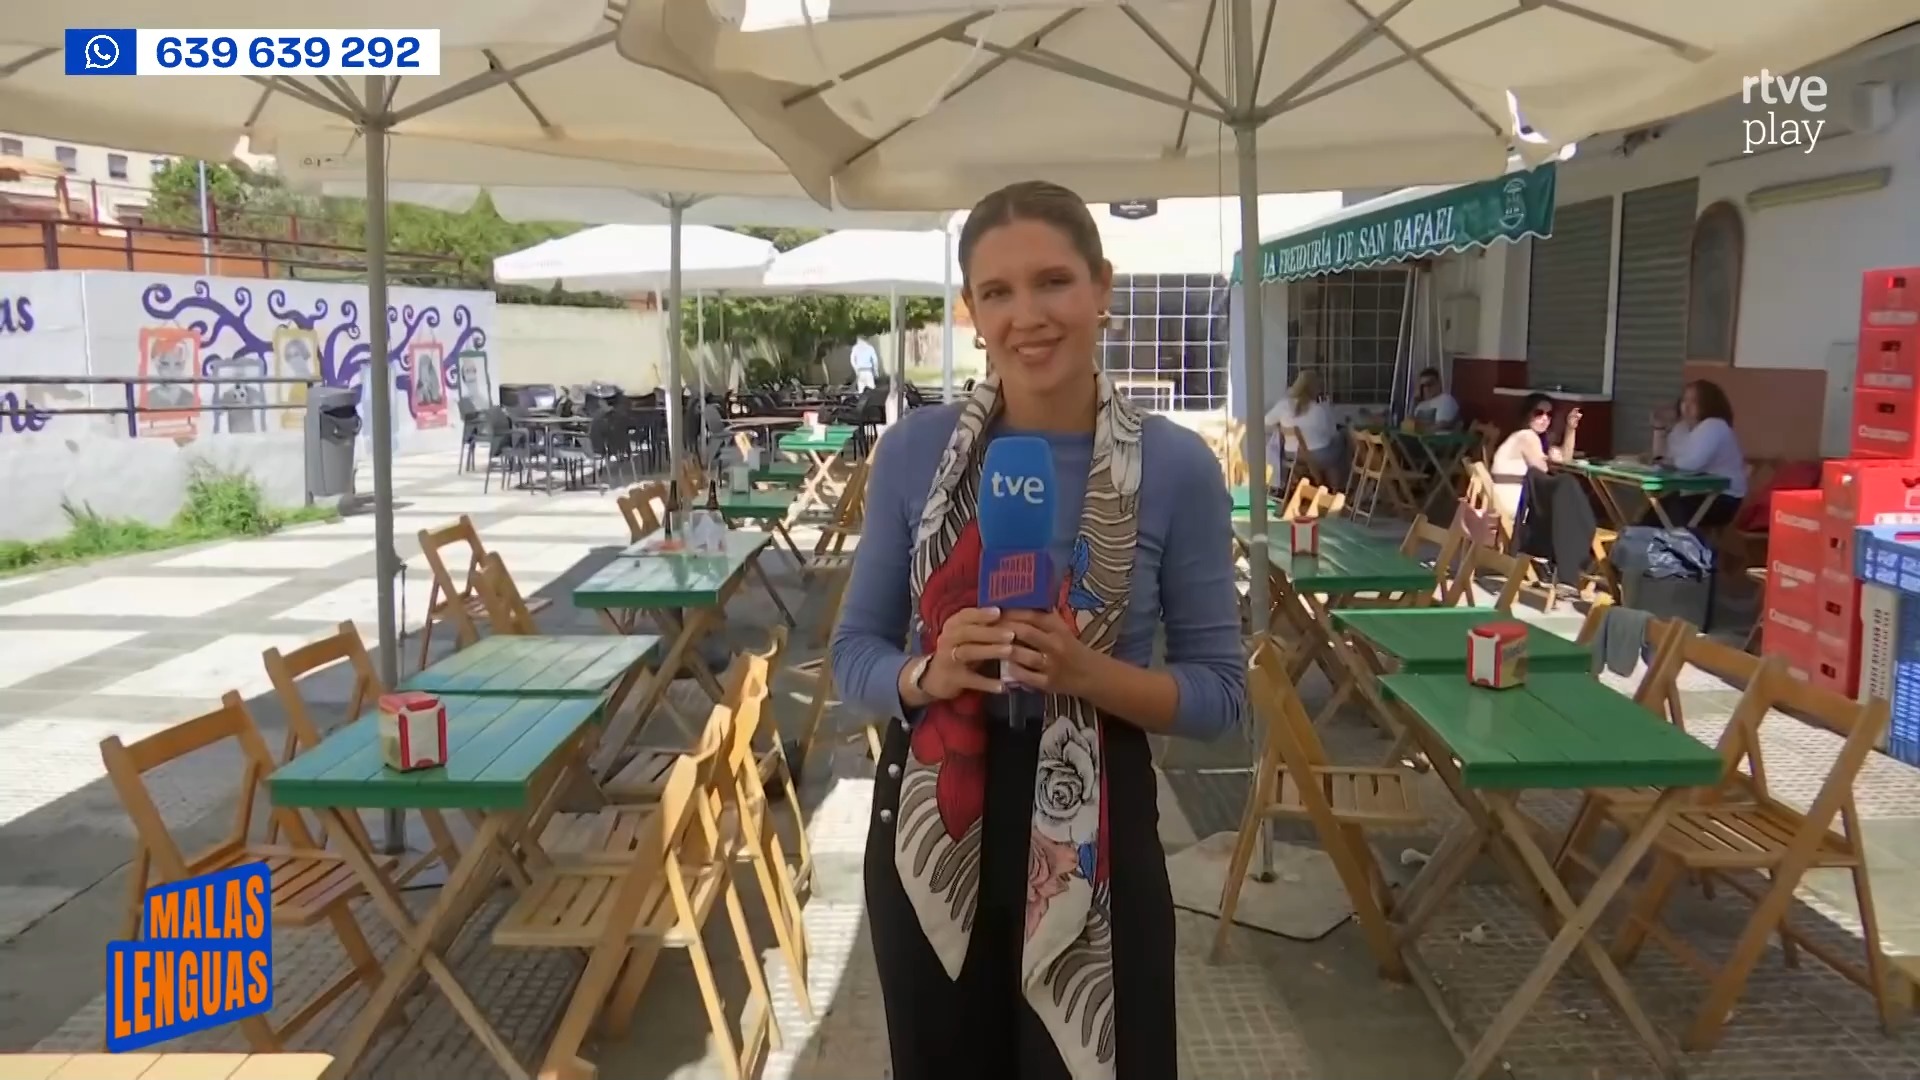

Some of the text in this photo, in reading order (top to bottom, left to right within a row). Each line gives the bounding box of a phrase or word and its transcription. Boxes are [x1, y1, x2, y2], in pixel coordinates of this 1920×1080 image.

[1263, 206, 1456, 277] LA FREIDURÍA DE SAN RAFAEL
[991, 471, 1045, 504] tve
